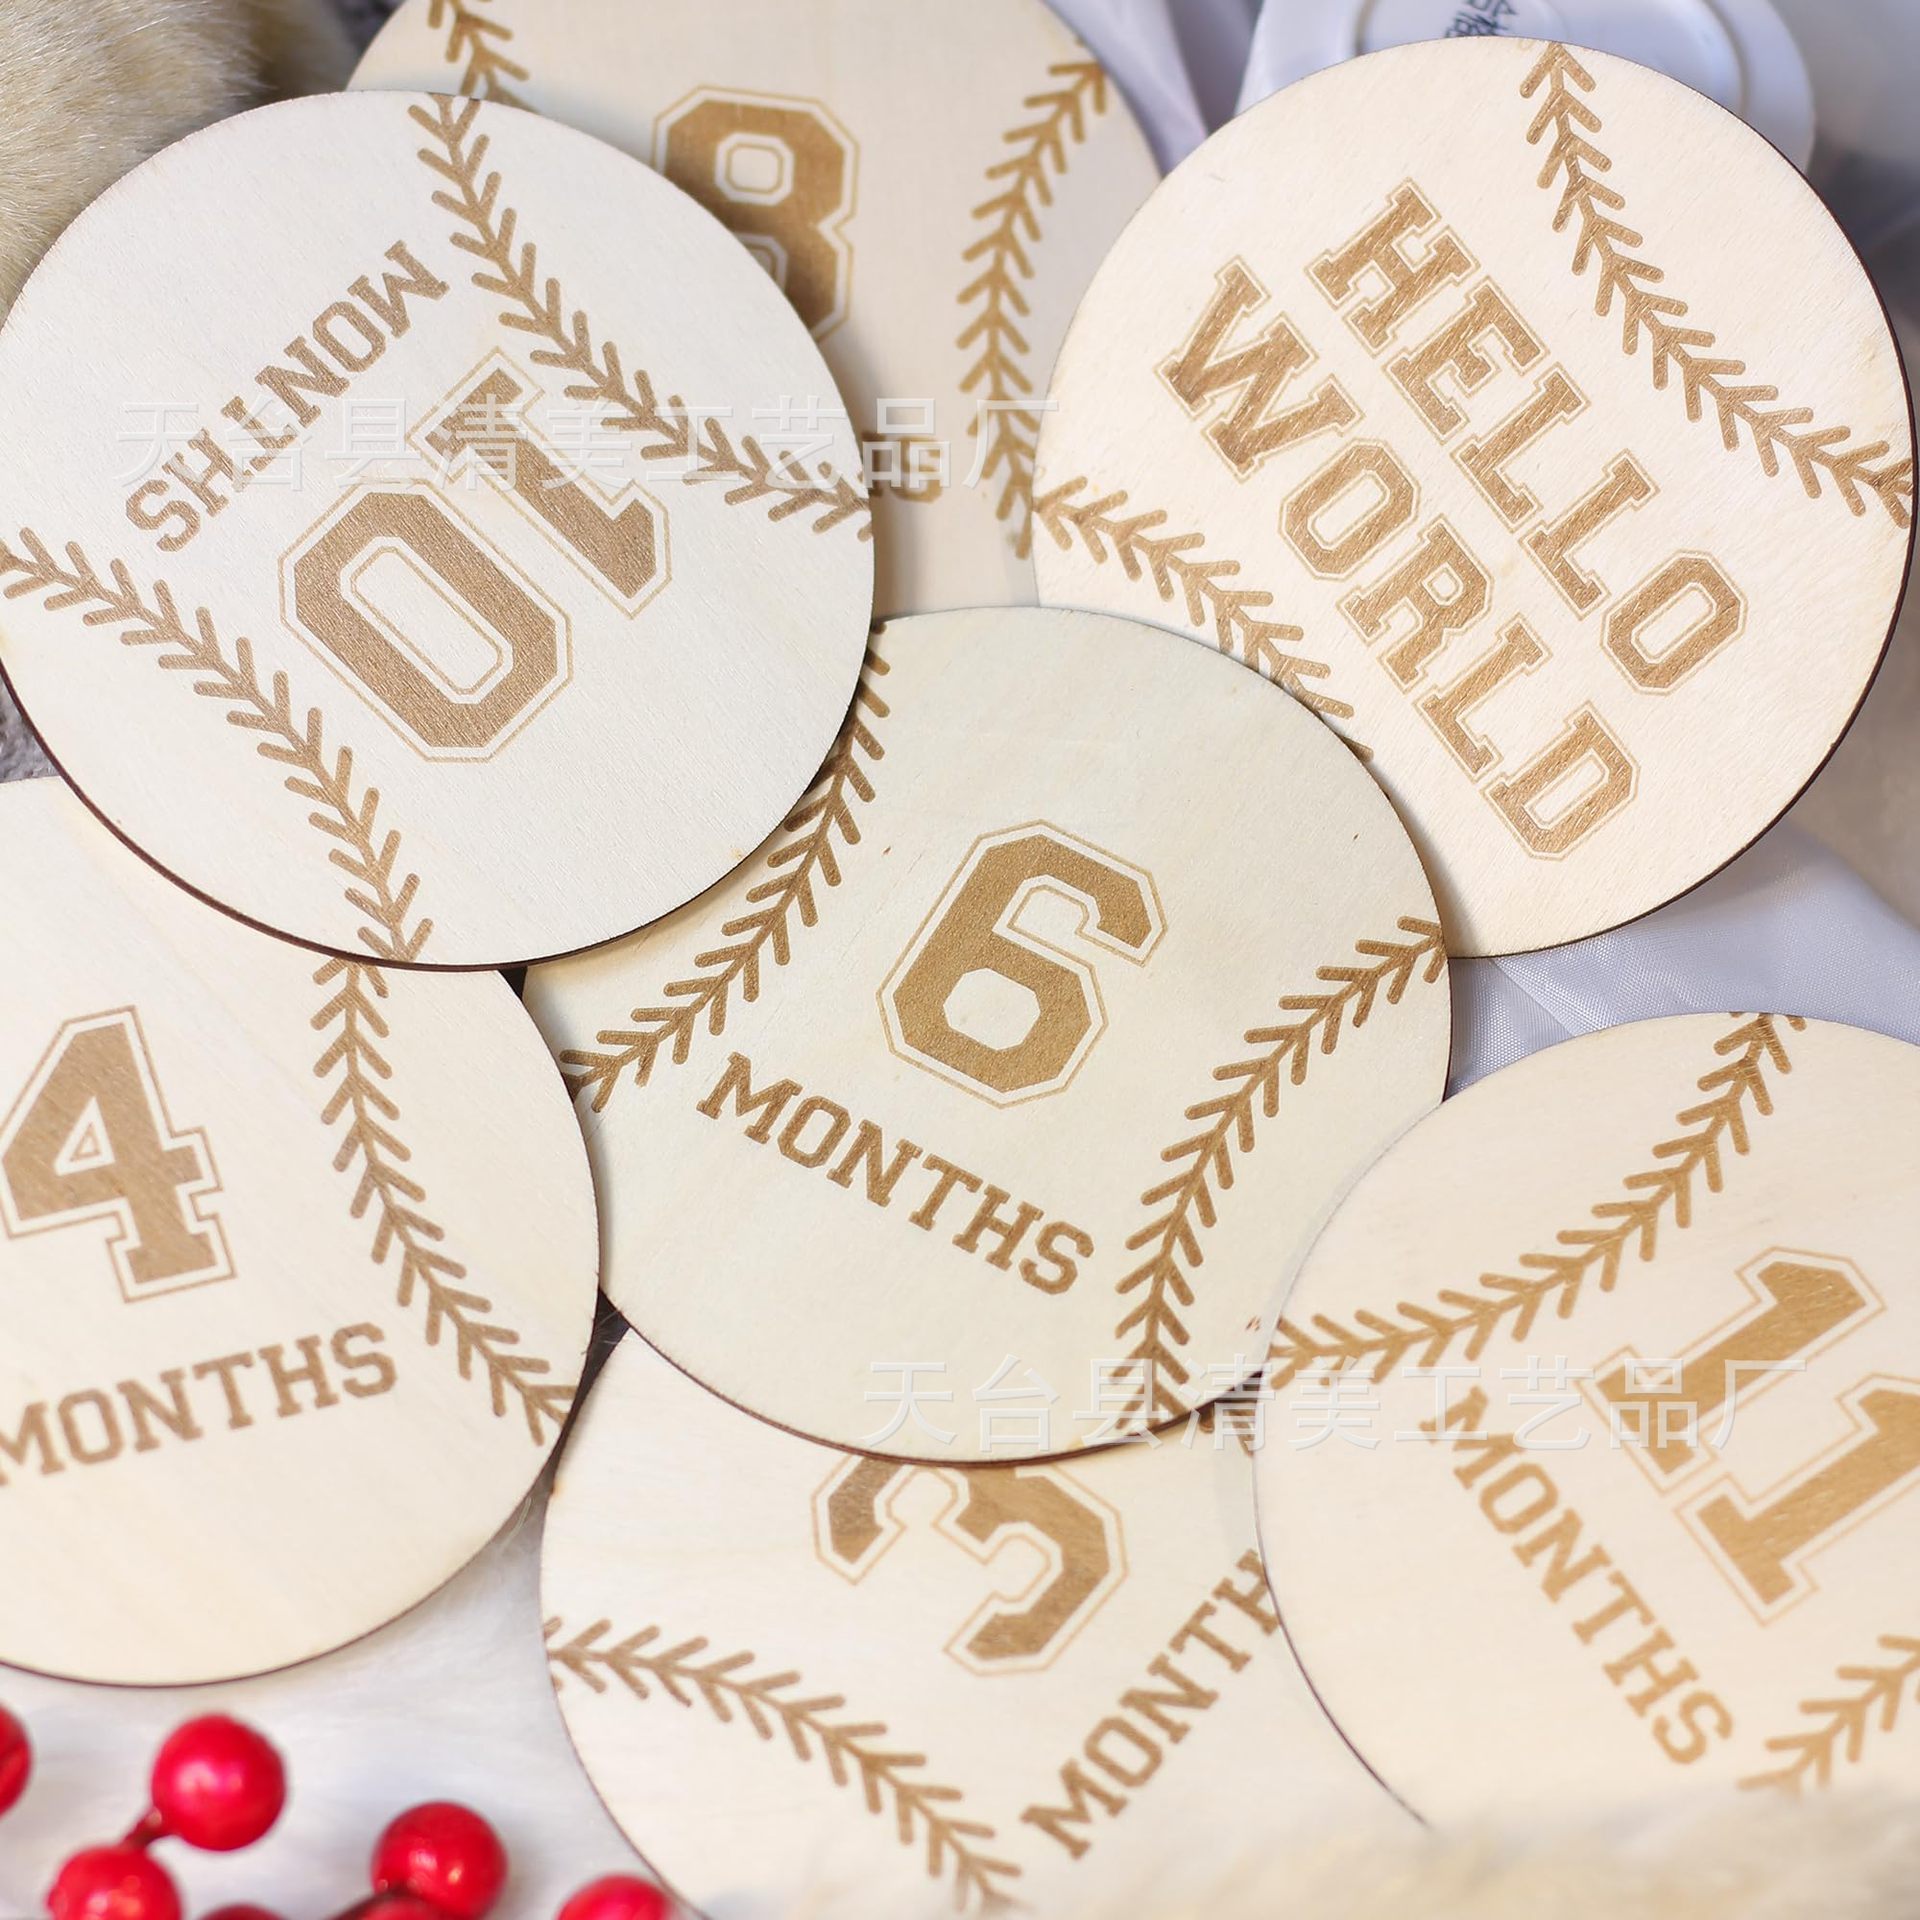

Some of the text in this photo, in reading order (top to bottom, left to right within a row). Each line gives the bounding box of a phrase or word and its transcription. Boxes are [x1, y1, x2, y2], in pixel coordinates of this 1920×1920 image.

[651, 85, 860, 342] 8
[125, 240, 450, 552] MONTHS
[277, 346, 673, 763] 10
[1154, 254, 1641, 861] WORLD
[1304, 178, 1748, 695] HELLO
[876, 819, 1168, 1109] 6
[0, 1004, 237, 1303] 4
[696, 1052, 1094, 1296] MONTHS
[1418, 1385, 1734, 1766] MONTHS
[1573, 1246, 1920, 1627] 11
